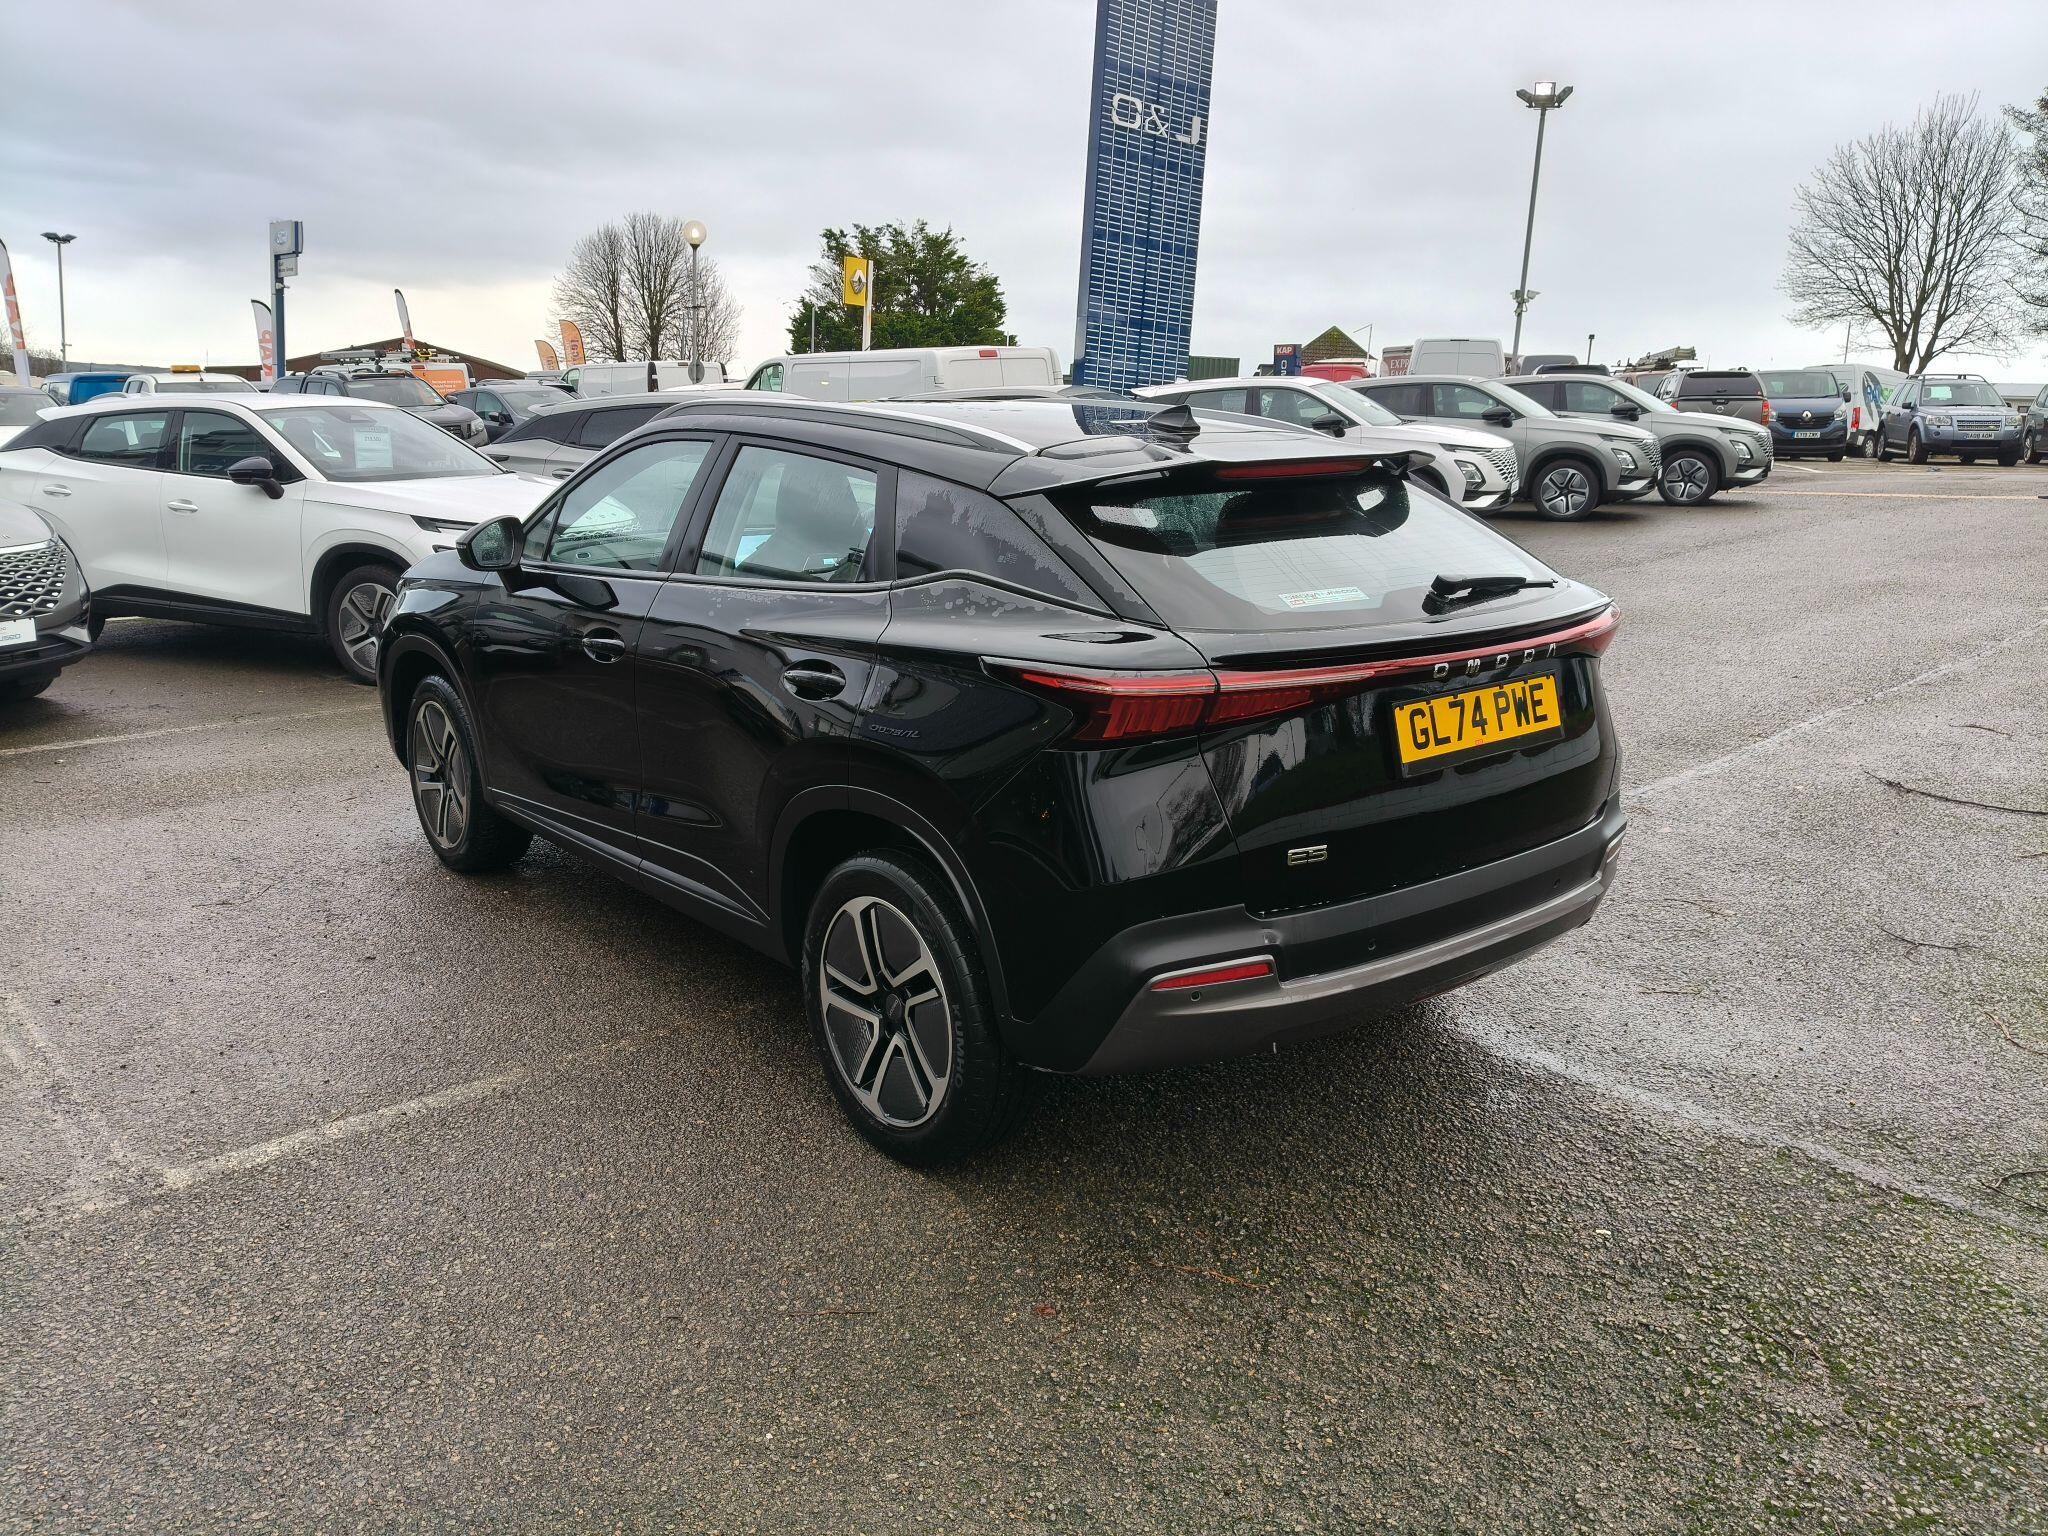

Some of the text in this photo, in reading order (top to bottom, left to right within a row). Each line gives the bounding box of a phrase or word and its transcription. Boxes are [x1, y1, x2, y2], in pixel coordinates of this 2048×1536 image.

[1276, 346, 1293, 354] KAP
[1433, 642, 1557, 679] OMODA
[1409, 682, 1549, 751] GL74 PWE
[1287, 844, 1328, 866] E5
[952, 1004, 967, 1089] KUMHO
